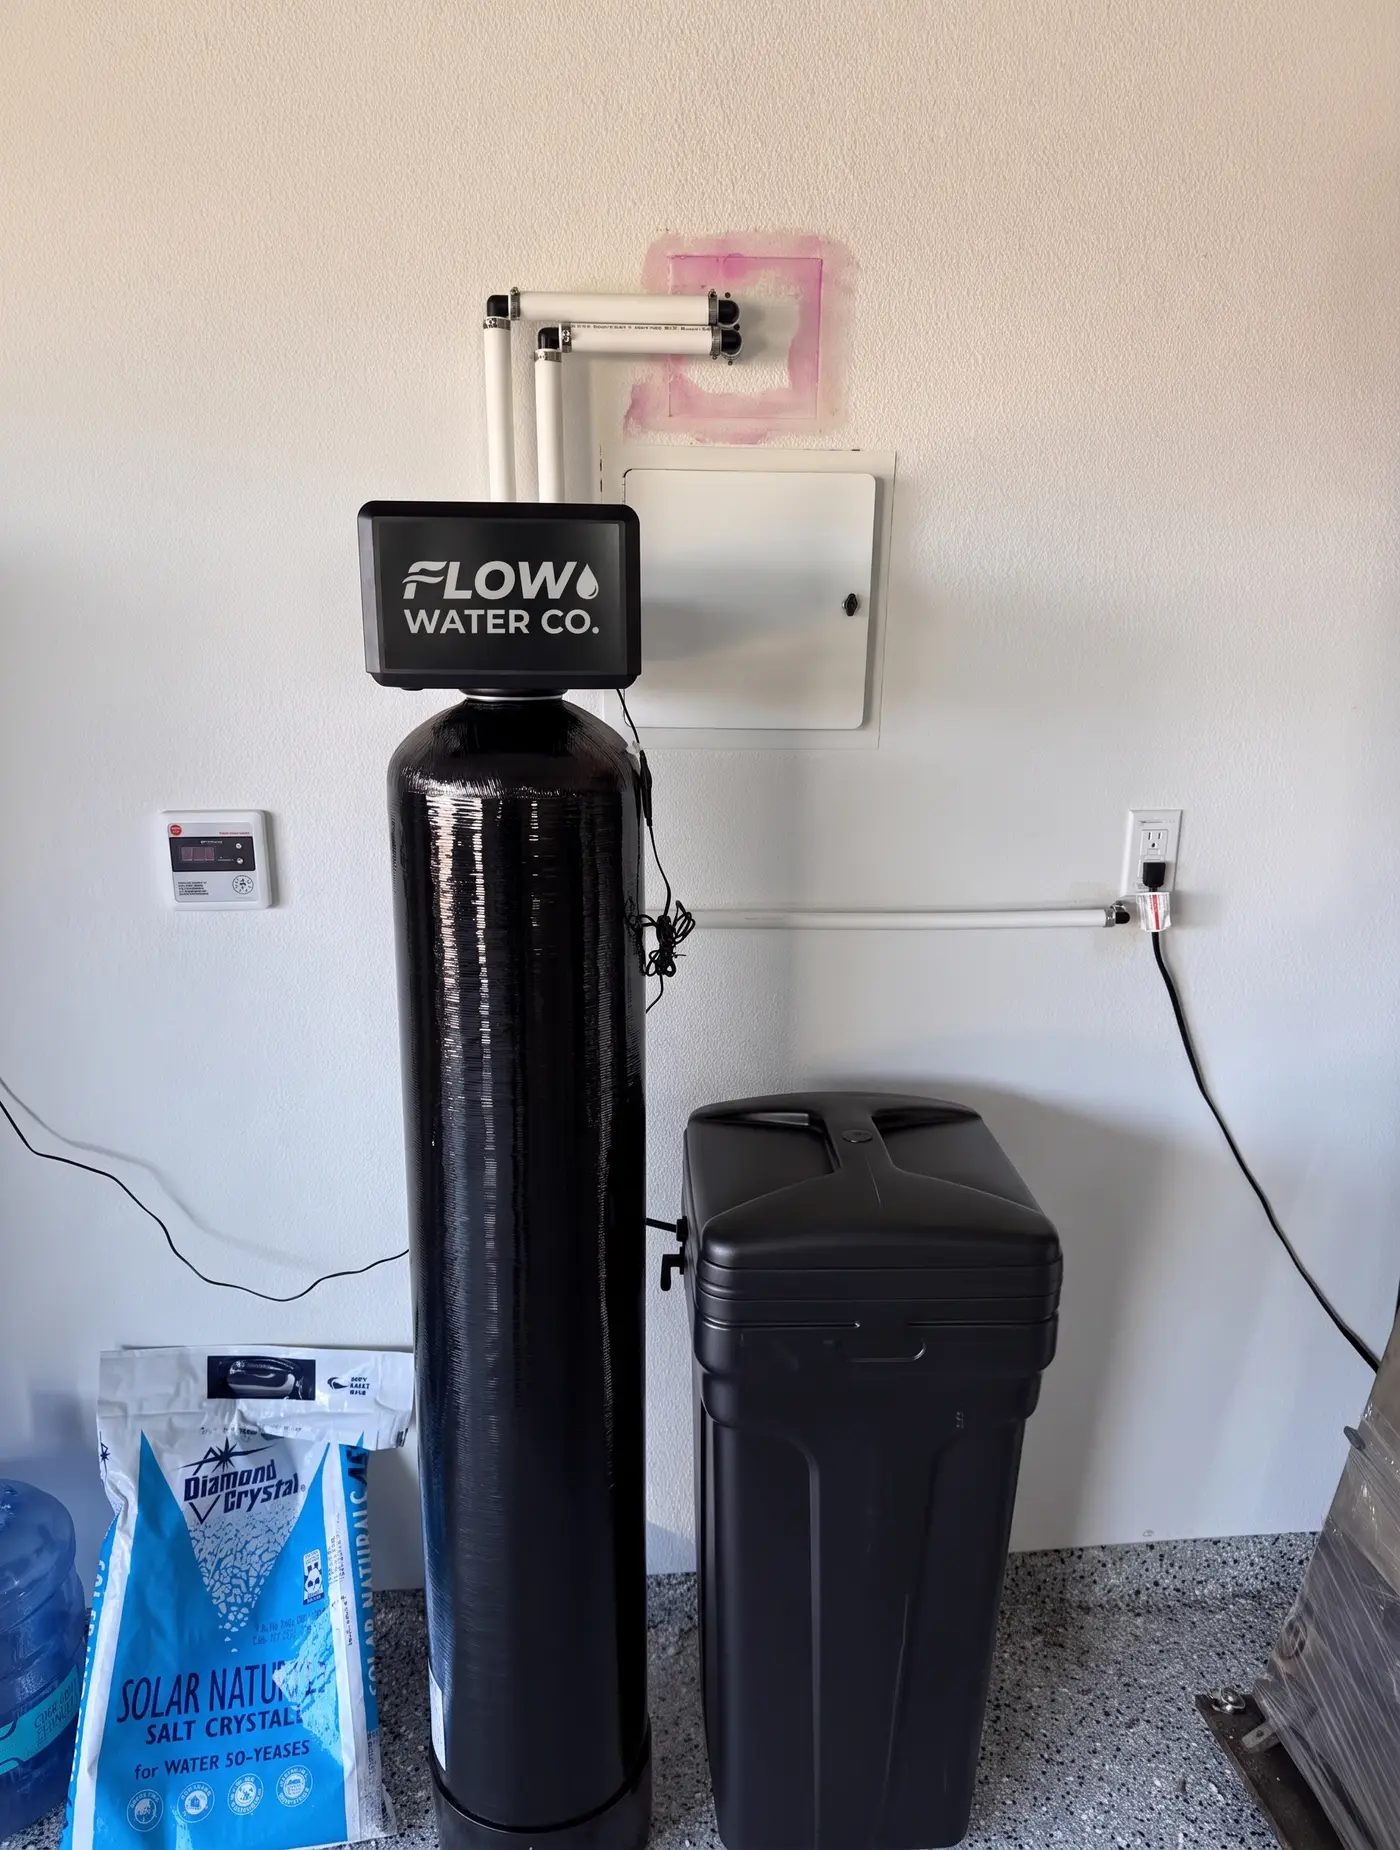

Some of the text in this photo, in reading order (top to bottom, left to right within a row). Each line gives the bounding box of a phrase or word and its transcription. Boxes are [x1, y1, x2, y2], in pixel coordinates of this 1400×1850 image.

[402, 561, 577, 600] FLOW
[403, 609, 599, 635] WATER CO.
[184, 1459, 277, 1501] Diamond
[223, 1473, 299, 1513] Crystal
[116, 1673, 200, 1723] SOLAR
[209, 1659, 325, 1711] NATU
[145, 1720, 196, 1745] SALT
[135, 1764, 159, 1780] for
[165, 1754, 220, 1776] WATER
